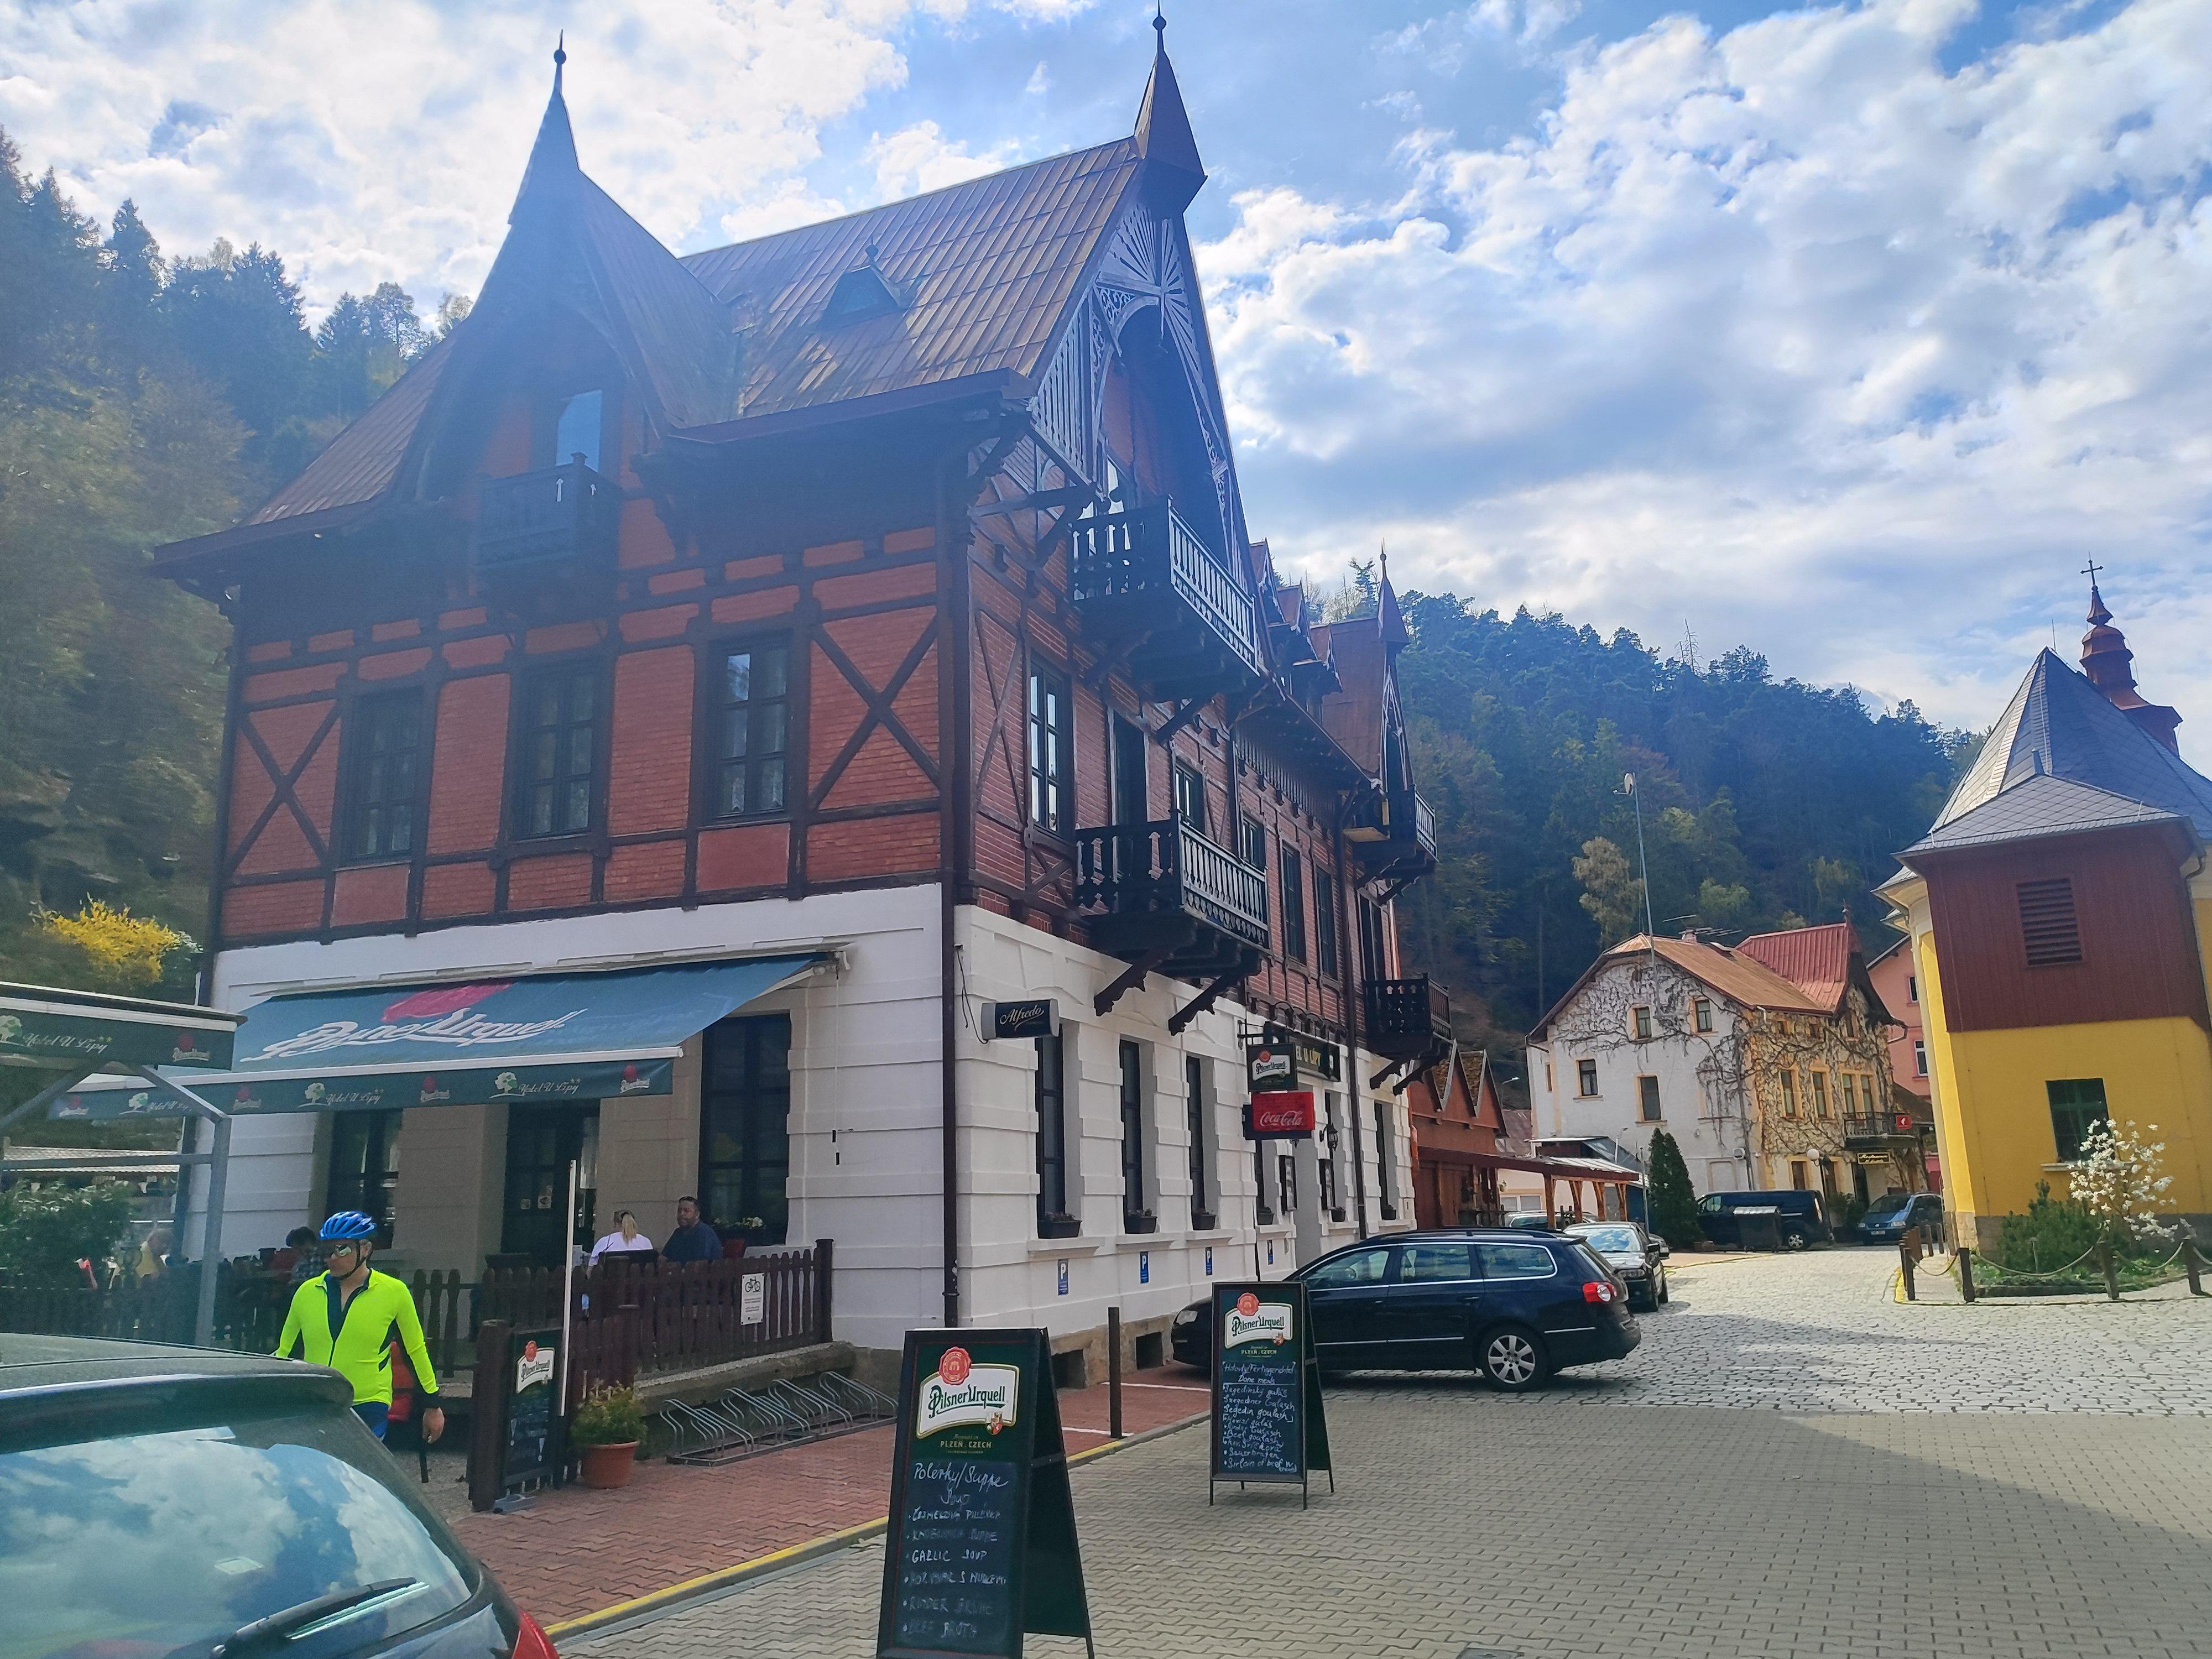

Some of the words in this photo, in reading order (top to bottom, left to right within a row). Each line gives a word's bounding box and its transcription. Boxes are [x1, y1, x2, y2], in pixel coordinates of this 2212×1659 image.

[1000, 1004, 1045, 1025] Alfredo
[1141, 1255, 1147, 1270] P
[1207, 1250, 1211, 1264] P
[1060, 1263, 1066, 1280] P
[1232, 1316, 1259, 1337] Pilsner
[1258, 1314, 1285, 1331] Urquell
[1238, 1374, 1255, 1383] Done
[928, 1385, 968, 1419] Pilsner
[967, 1384, 1005, 1409] Urquell
[1223, 1404, 1254, 1418] Segedin
[1227, 1429, 1246, 1438] Beef
[912, 1549, 951, 1564] GARLIC
[961, 1548, 988, 1561] SOUP
